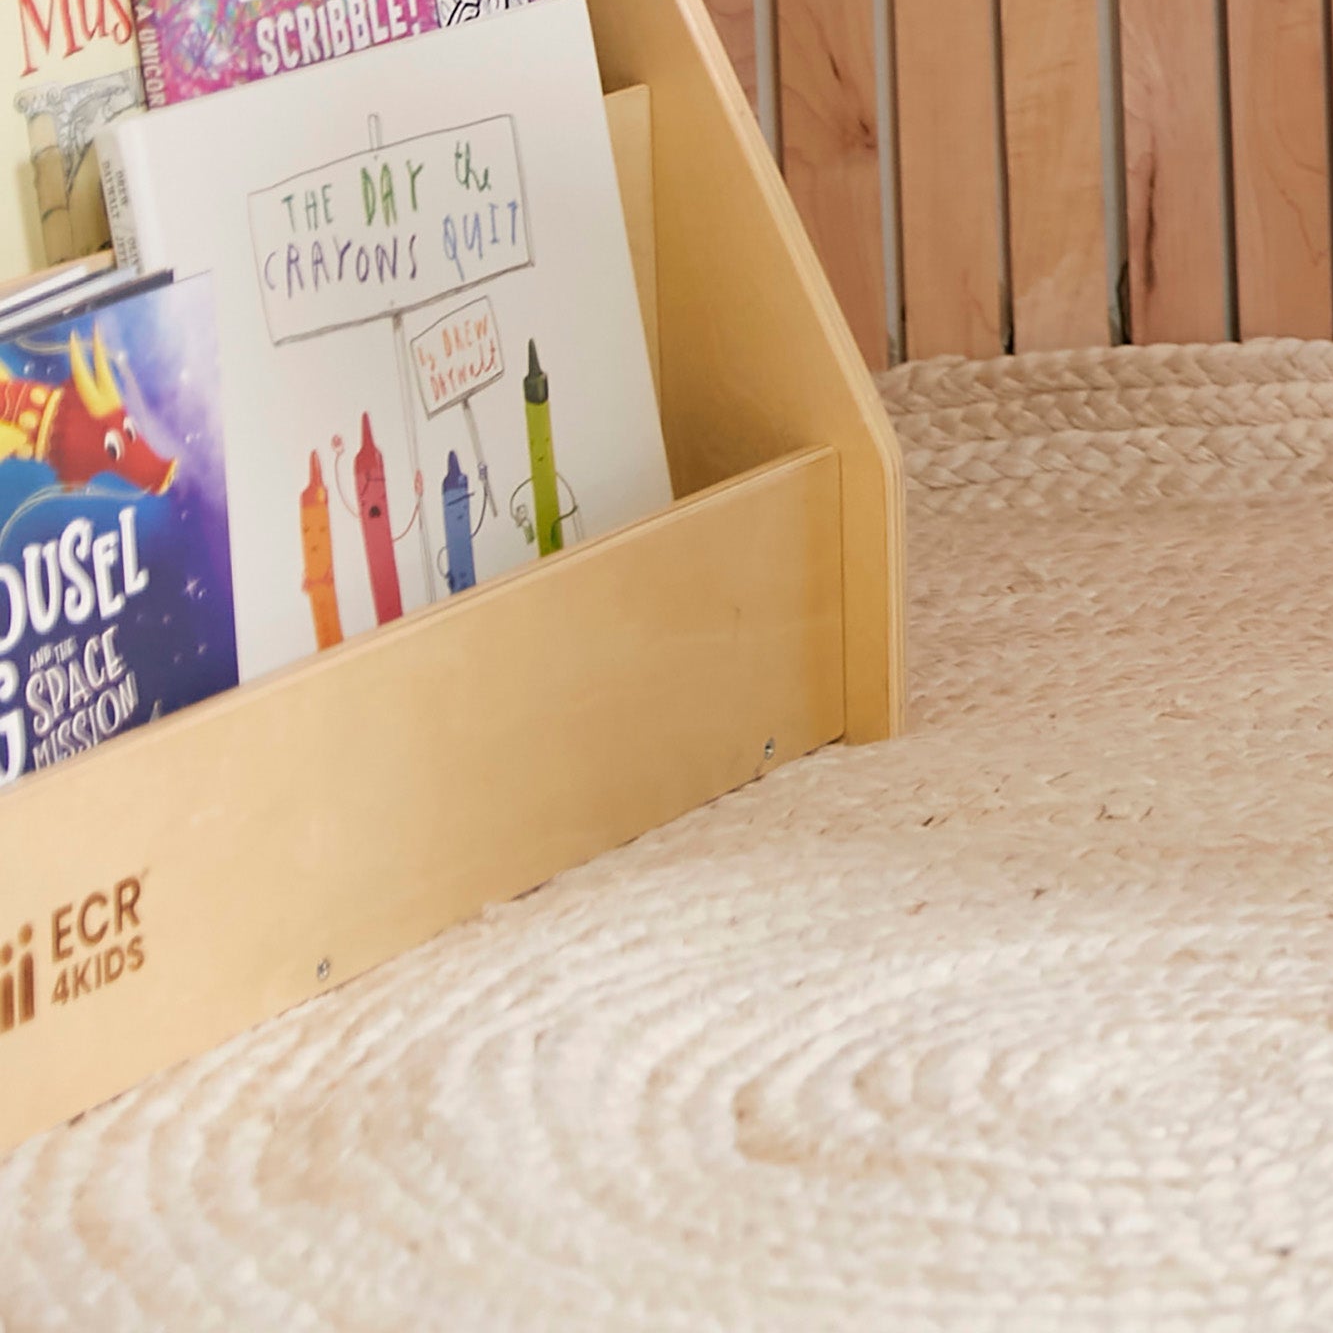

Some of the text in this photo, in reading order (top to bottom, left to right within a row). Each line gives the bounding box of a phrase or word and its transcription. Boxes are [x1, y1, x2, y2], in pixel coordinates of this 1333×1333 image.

[135, 3, 154, 23] A
[281, 141, 493, 233] THE DAY the
[263, 199, 521, 300] CRAYONS QUIT
[442, 314, 488, 358] DREW
[25, 624, 128, 736] SPACE
[29, 635, 79, 674] AND THE
[32, 669, 141, 773] MISSION
[52, 876, 141, 963] ECR
[51, 935, 146, 1007] 4KIDS
